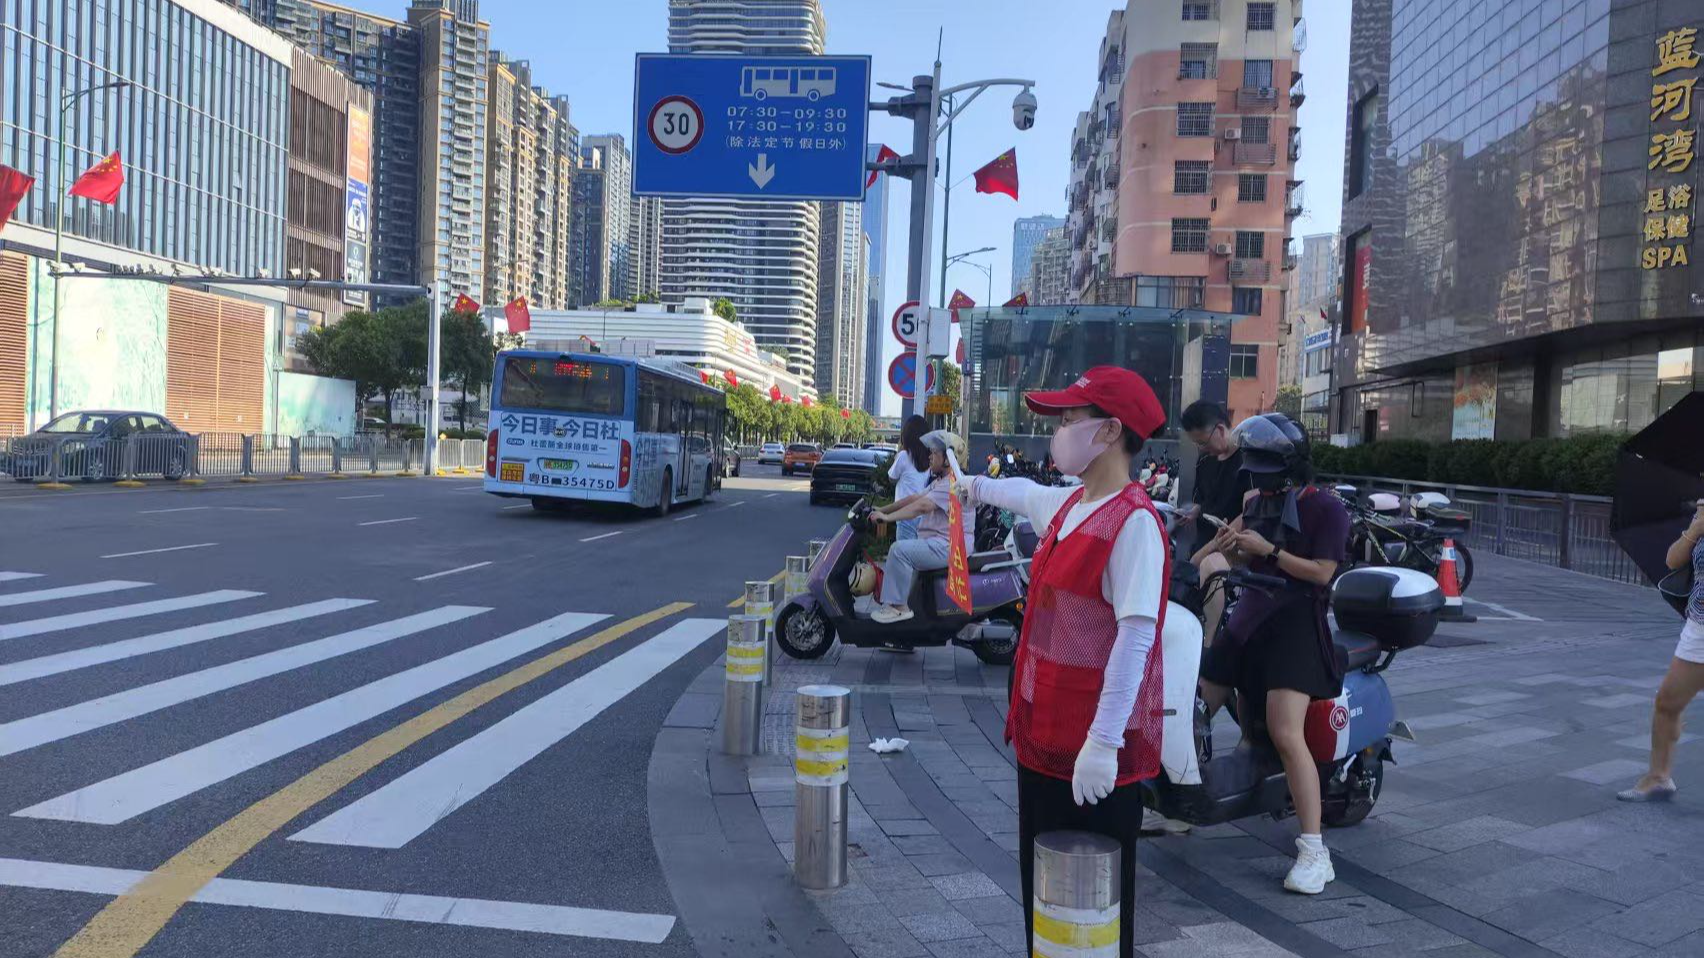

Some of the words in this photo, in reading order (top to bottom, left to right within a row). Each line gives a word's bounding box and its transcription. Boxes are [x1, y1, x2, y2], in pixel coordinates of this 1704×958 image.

[1648, 27, 1701, 174] 蓝河湾
[663, 112, 690, 136] 30
[1643, 182, 1691, 213] 足浴
[1643, 214, 1690, 242] 保健
[1641, 244, 1688, 270] SPA
[901, 313, 919, 335] 5
